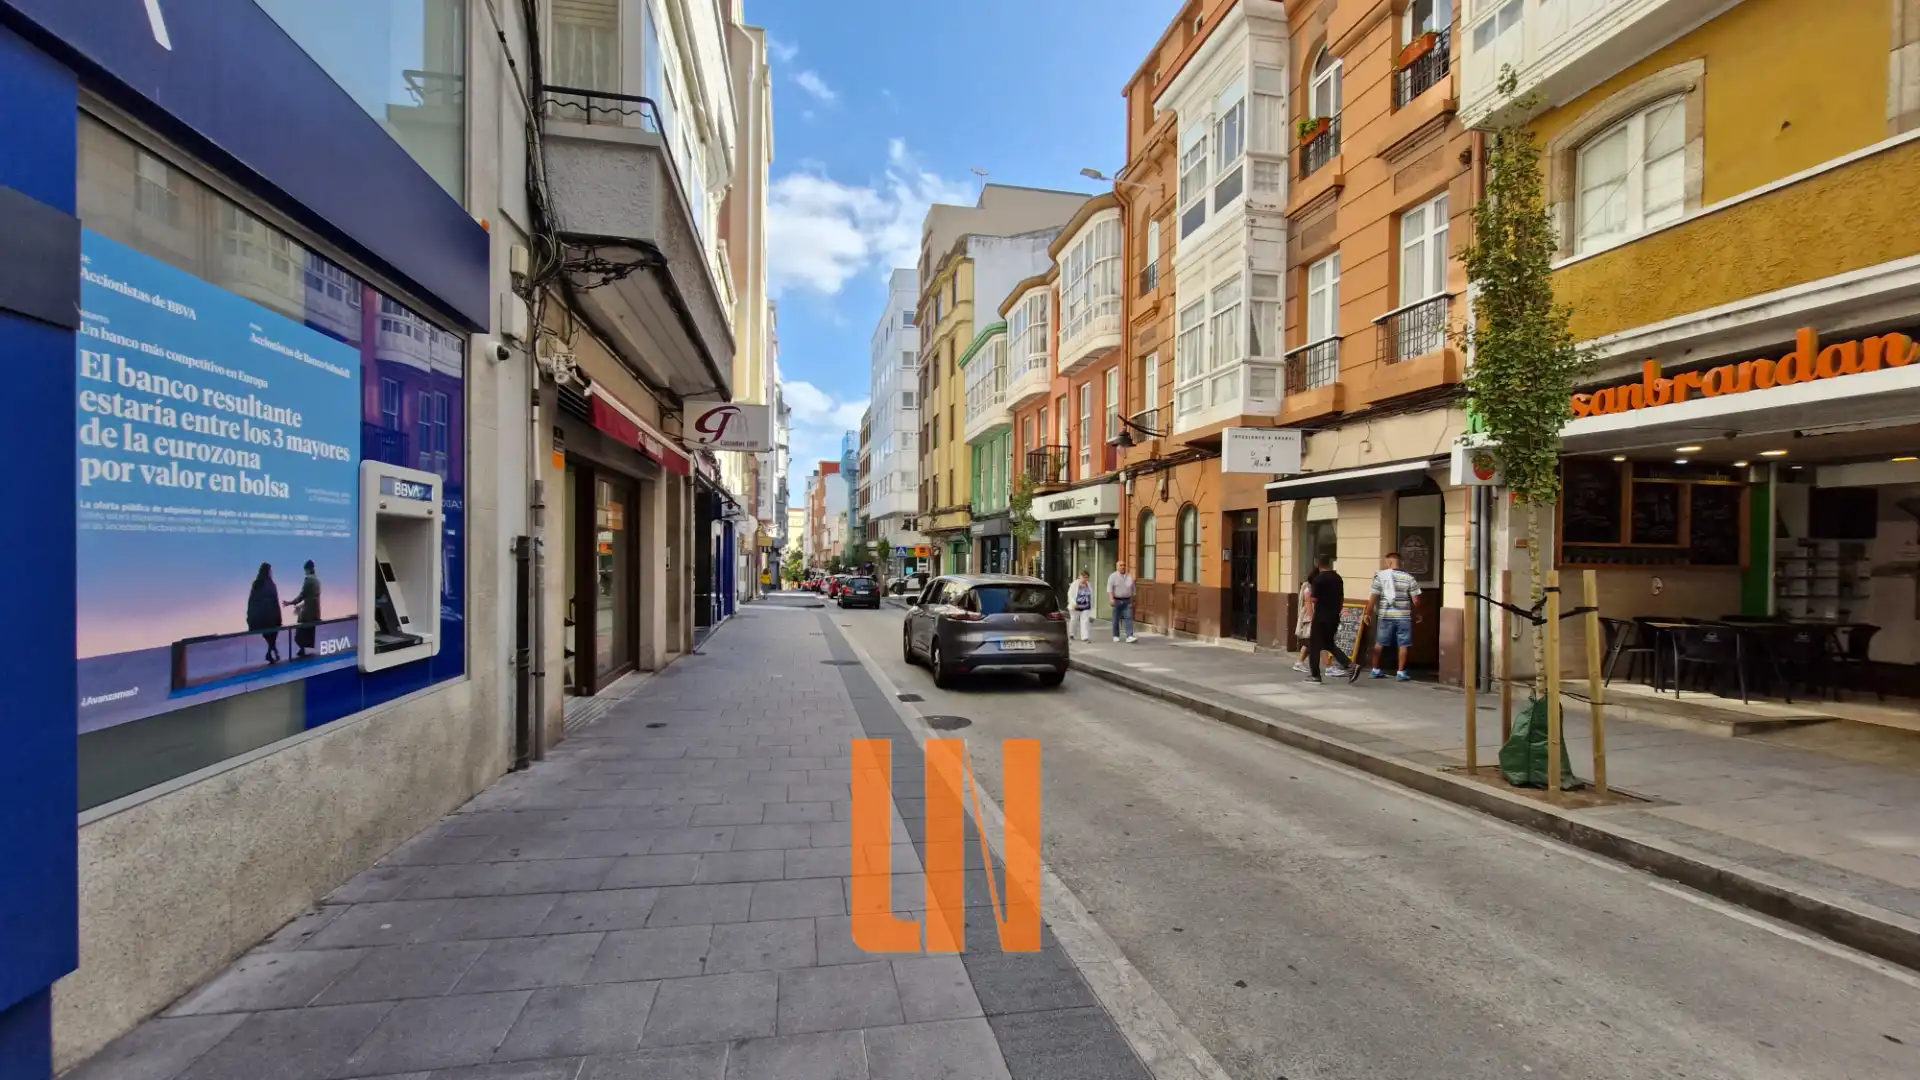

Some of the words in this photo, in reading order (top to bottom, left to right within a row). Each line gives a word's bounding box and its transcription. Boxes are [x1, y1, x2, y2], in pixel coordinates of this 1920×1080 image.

[80, 266, 150, 303] Accionistas
[152, 294, 167, 309] de
[167, 300, 197, 320] BBVA
[80, 321, 99, 338] Un
[100, 326, 139, 349] banco
[141, 342, 165, 357] más
[165, 350, 226, 376] competitivo
[226, 368, 237, 379] en
[238, 369, 268, 389] Europa
[250, 332, 294, 357] Accionistas
[294, 348, 304, 361] de
[80, 349, 112, 383] El
[117, 357, 199, 402] banco
[202, 387, 303, 428] resultante
[1571, 327, 1920, 418] sanbrandan
[80, 389, 178, 428] estaría
[181, 411, 241, 440] entre
[244, 419, 270, 446] los
[273, 428, 284, 448] 3
[287, 433, 350, 462] mayores
[80, 416, 119, 448] de
[123, 422, 150, 453] la
[154, 436, 261, 470] eurozona
[80, 457, 135, 486] por
[138, 461, 206, 489] valor
[209, 473, 236, 493] en
[240, 470, 290, 498] bolsa
[394, 481, 420, 498] BBVA
[80, 499, 91, 509] La
[320, 635, 351, 656] BBVA
[81, 686, 139, 707] ¿Avanzamos?
